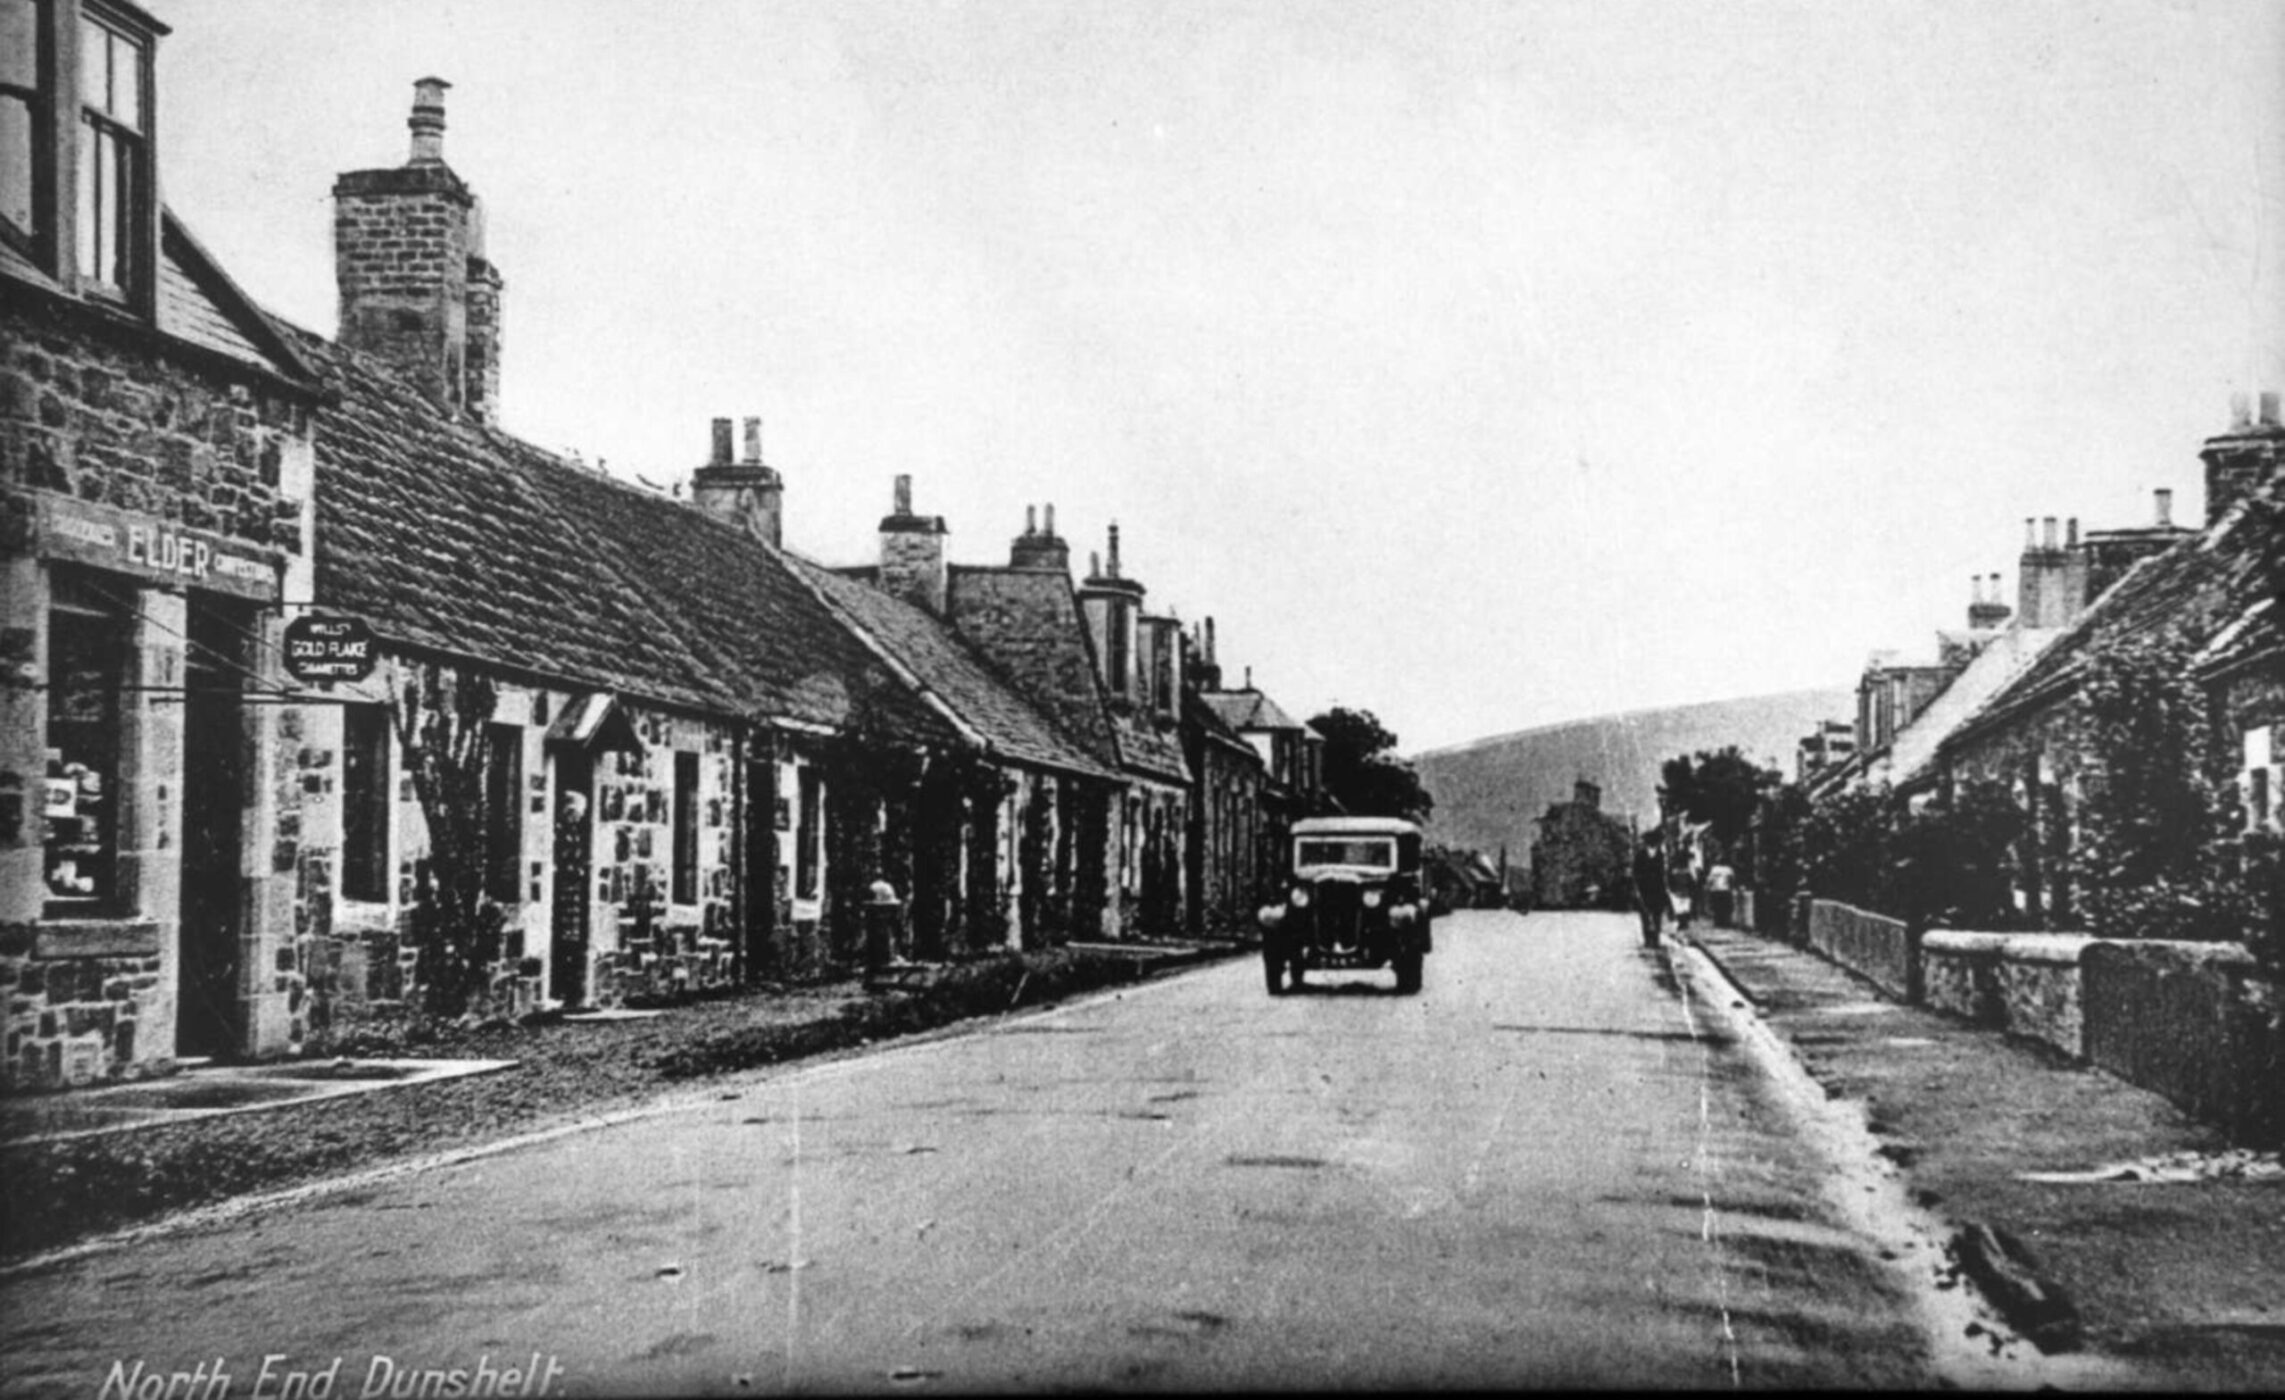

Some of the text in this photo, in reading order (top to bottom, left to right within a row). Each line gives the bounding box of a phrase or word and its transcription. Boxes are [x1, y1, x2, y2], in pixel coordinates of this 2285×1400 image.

[127, 523, 209, 578] ELDER
[291, 639, 369, 659] GOLD FLAKE
